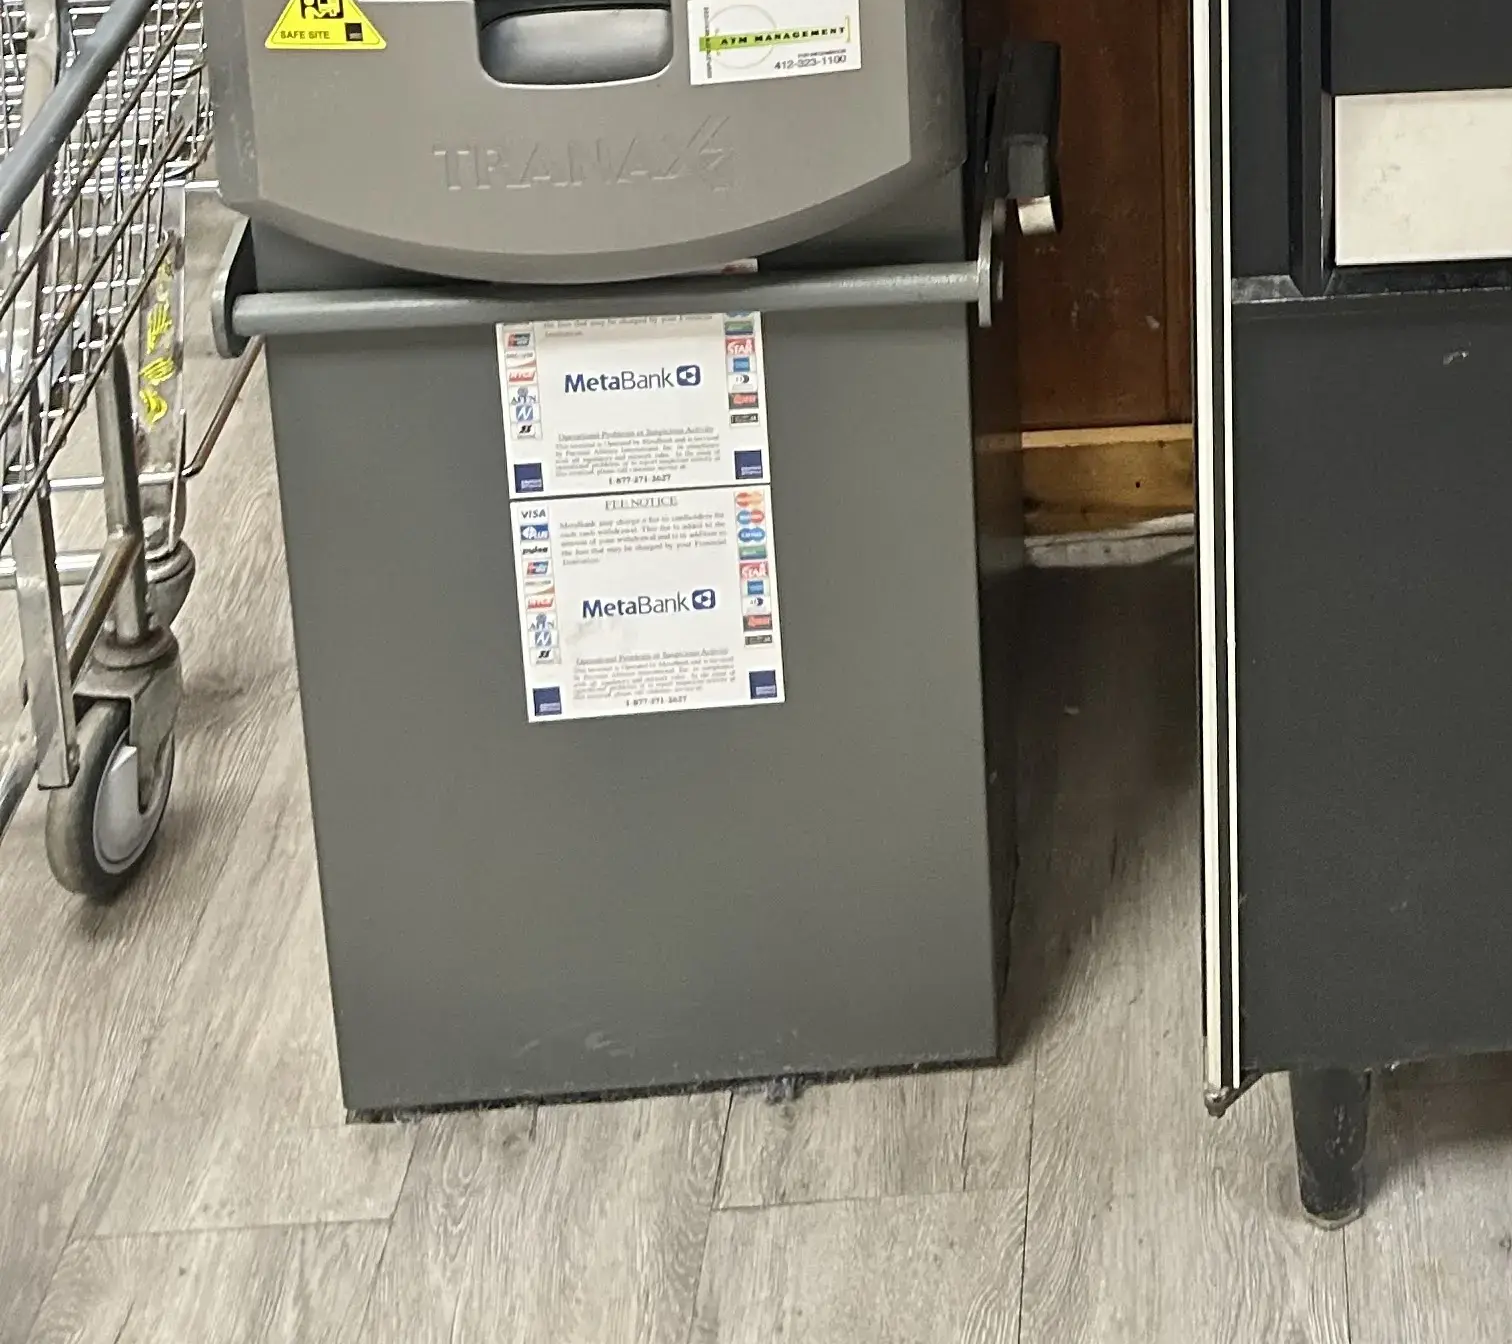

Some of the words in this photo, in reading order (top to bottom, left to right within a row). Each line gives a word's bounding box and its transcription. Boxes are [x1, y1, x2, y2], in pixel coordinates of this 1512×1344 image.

[280, 30, 306, 40] SAFE
[308, 30, 330, 40] SITE
[721, 37, 748, 46] ATM
[754, 26, 846, 43] MANAGEMENT
[774, 54, 847, 70] 412-323-1100
[564, 367, 675, 394] MetaBank
[521, 508, 546, 518] VISA
[582, 591, 691, 619] MetaBank
